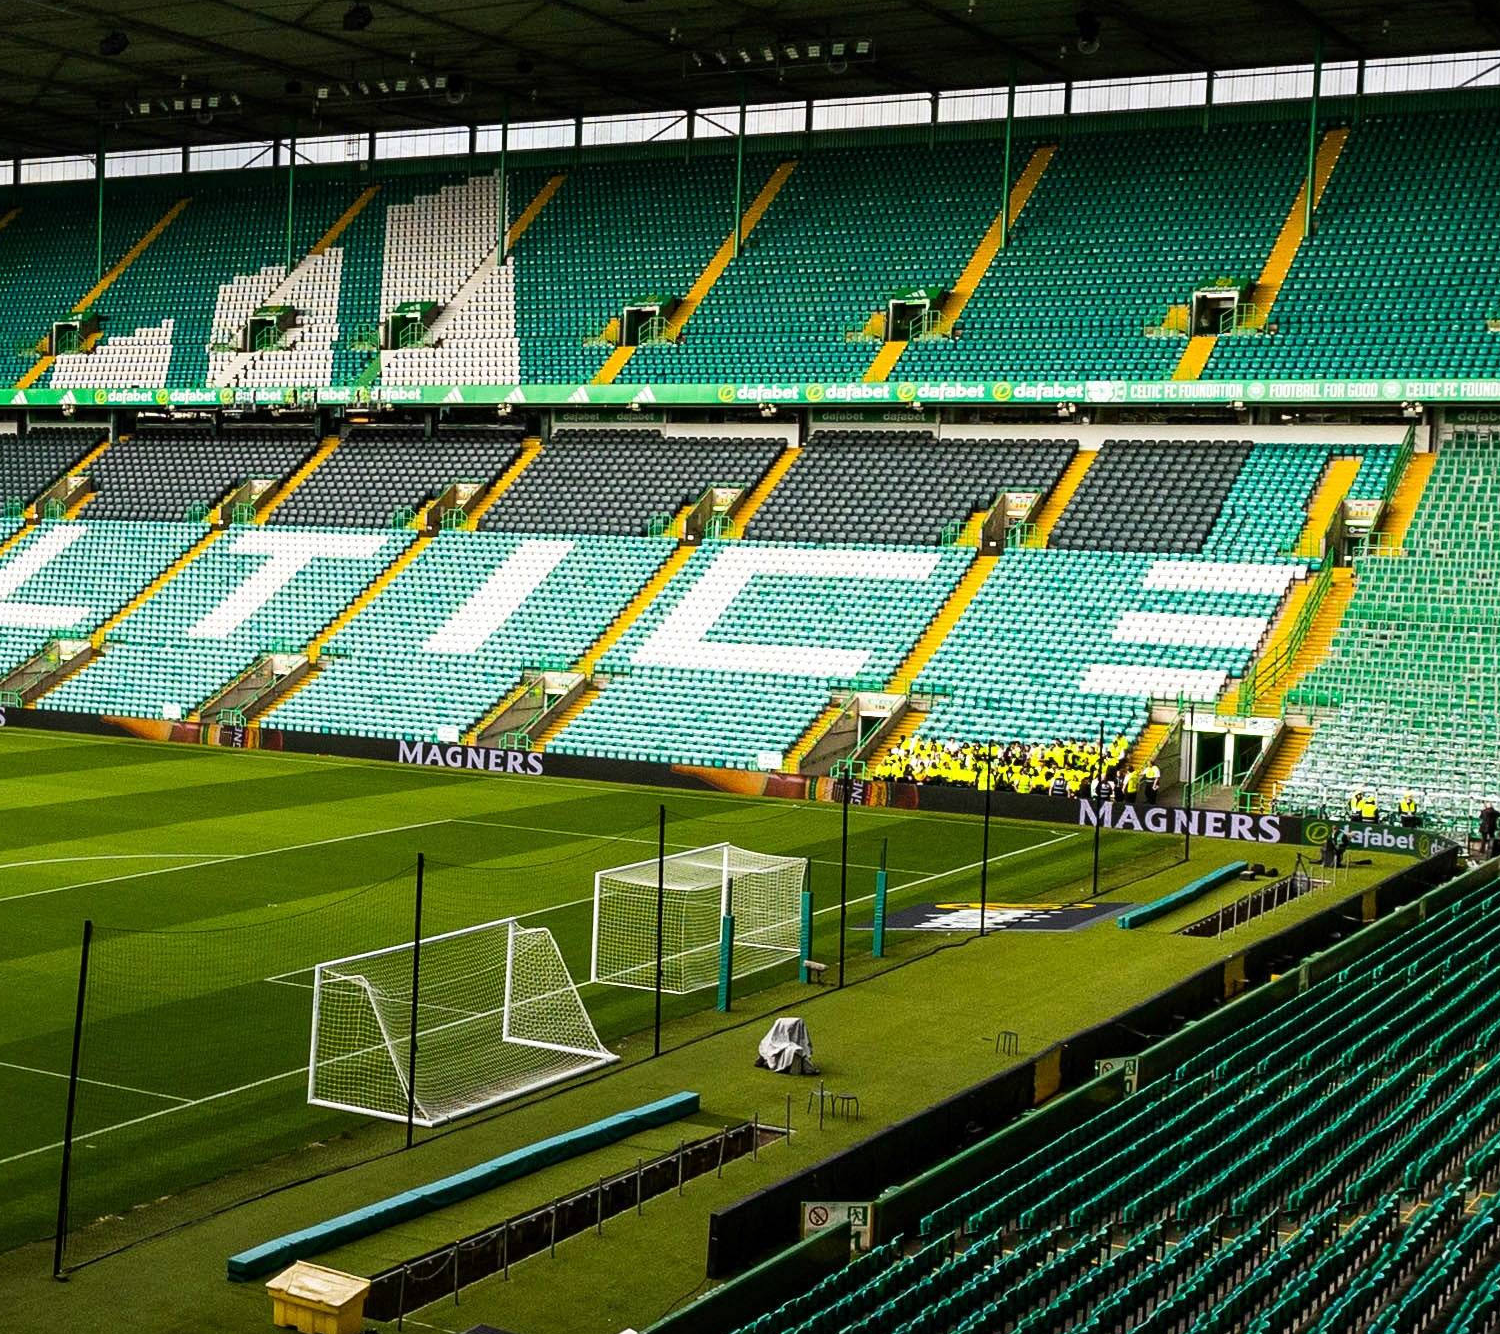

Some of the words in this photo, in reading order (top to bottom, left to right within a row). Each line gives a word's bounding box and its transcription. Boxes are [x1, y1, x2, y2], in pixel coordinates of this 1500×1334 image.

[108, 389, 152, 403] dafabet
[170, 389, 216, 403] dafabet
[737, 384, 799, 401] dafabet
[825, 383, 889, 400] dafabet
[918, 383, 985, 400] dafabet
[1014, 382, 1084, 399] dafabet
[398, 740, 543, 775] MAGNERS
[1079, 799, 1281, 844] MAGNERS
